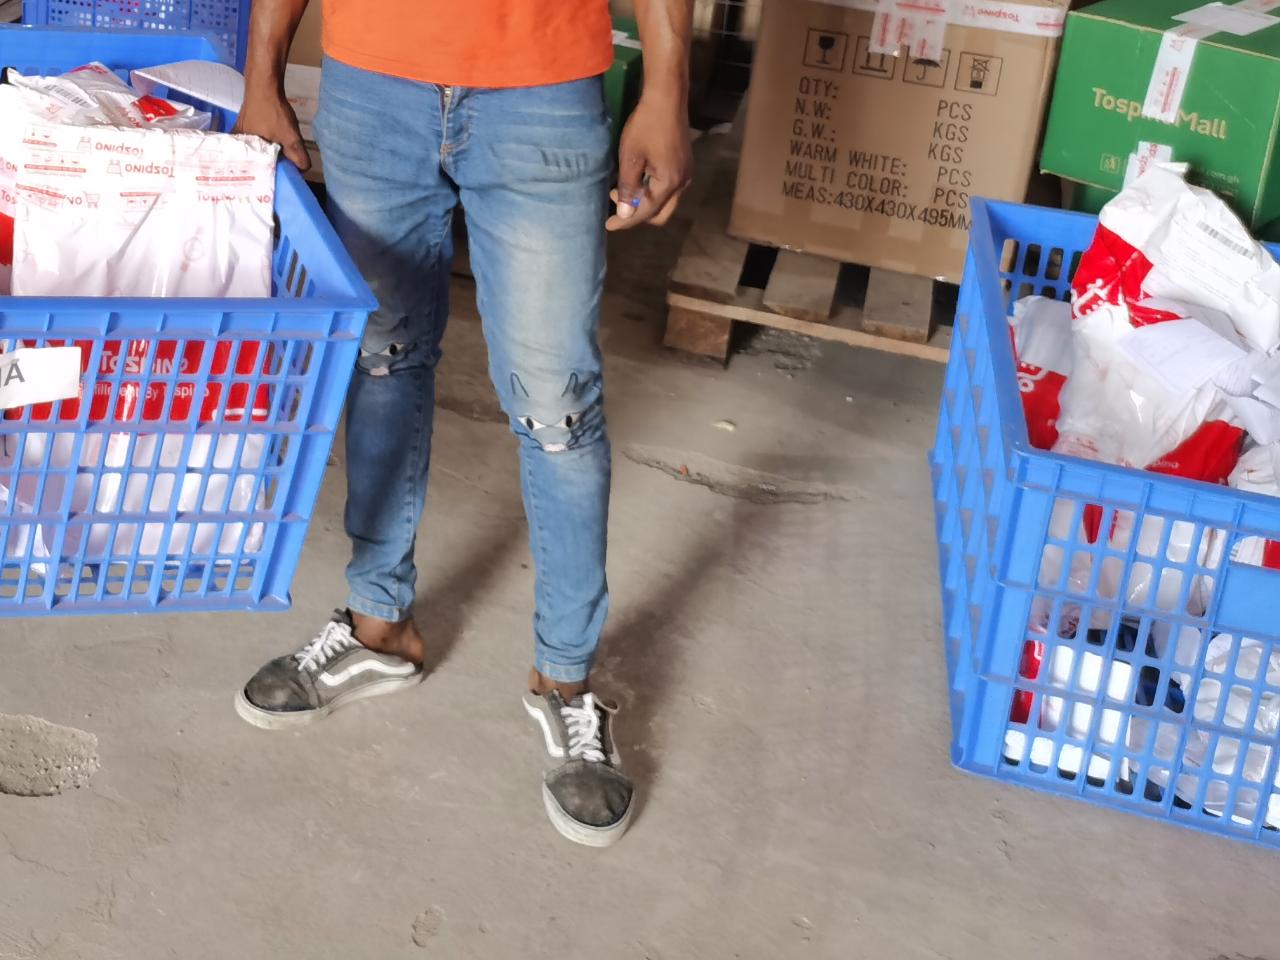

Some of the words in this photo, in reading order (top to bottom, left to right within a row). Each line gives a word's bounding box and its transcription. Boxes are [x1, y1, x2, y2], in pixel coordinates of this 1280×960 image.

[799, 76, 839, 99] QTY:
[936, 100, 972, 121] PCS
[1093, 87, 1227, 140] TospMall
[933, 121, 969, 143] KGS
[790, 140, 837, 162] WARM
[849, 150, 908, 176] WHITE:
[928, 143, 964, 164] KGS
[785, 160, 835, 185] MULTI
[846, 171, 908, 198] COLOR:
[936, 166, 972, 188] PCS
[933, 187, 969, 209] PCS
